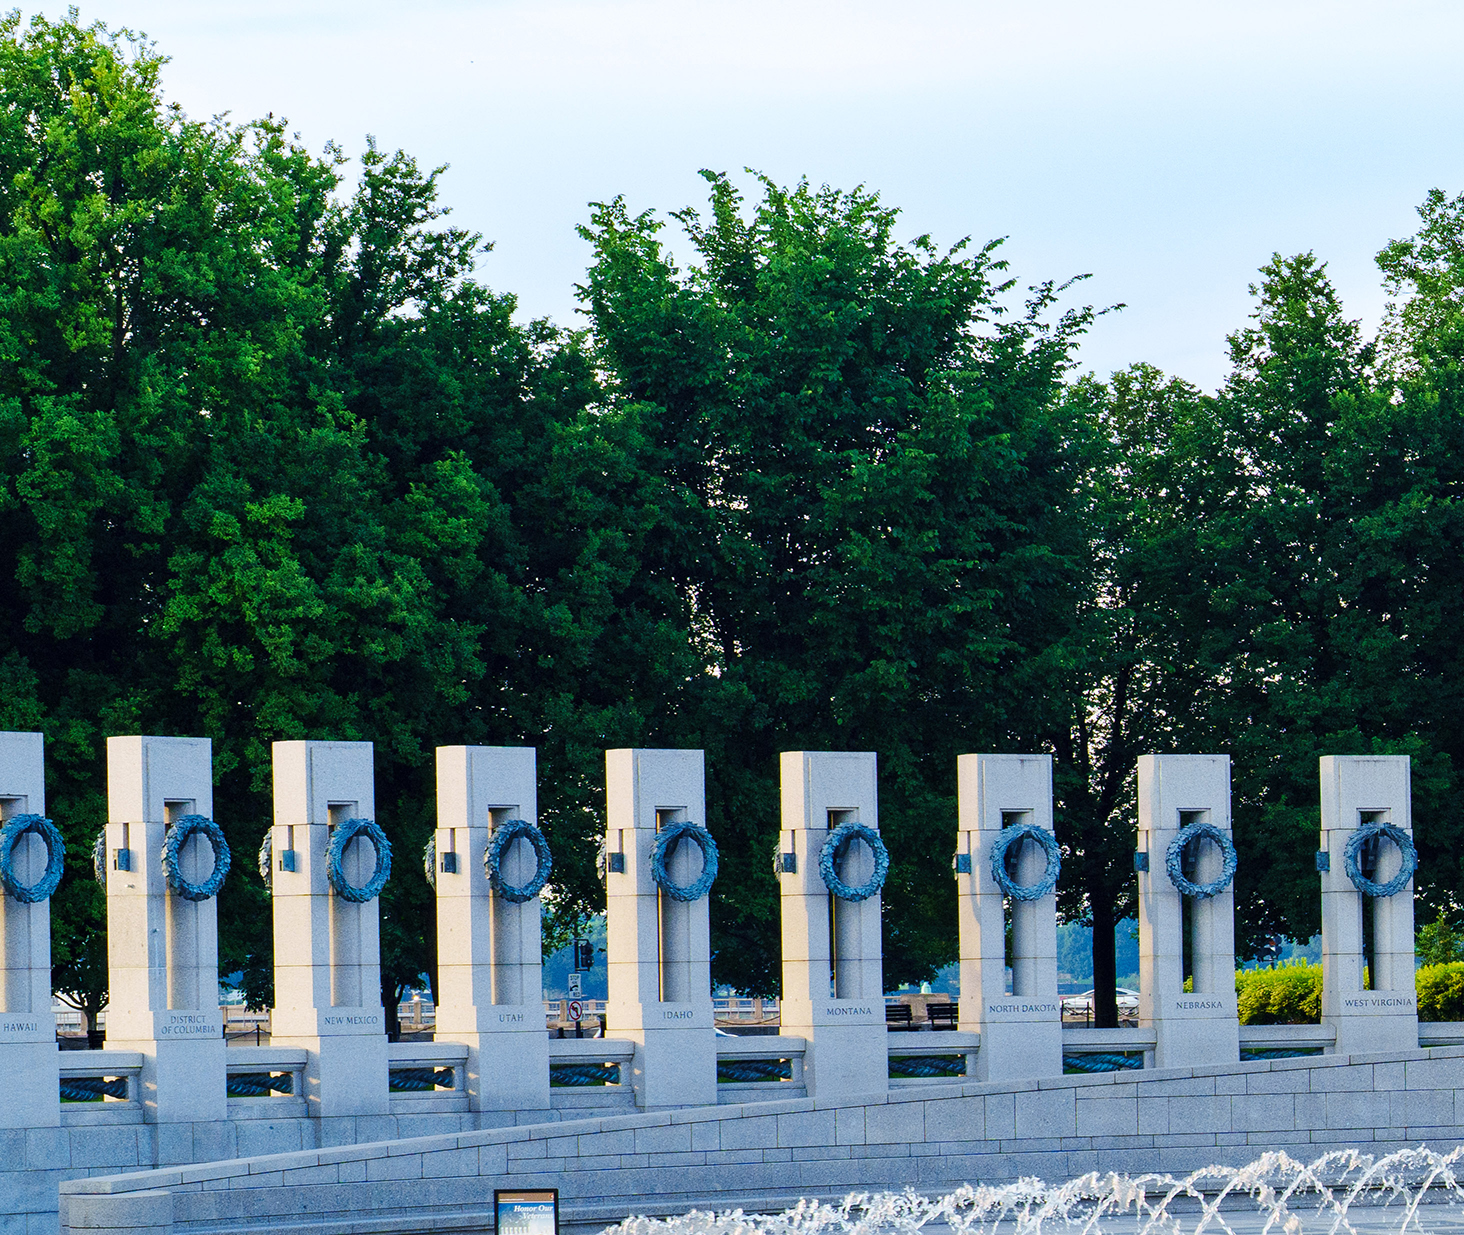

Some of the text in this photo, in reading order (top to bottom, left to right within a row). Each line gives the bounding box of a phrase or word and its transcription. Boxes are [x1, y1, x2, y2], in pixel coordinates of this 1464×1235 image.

[1176, 1001, 1223, 1010] NEBRASKA
[1344, 998, 1413, 1007] WEST VIRGINIA
[826, 1007, 872, 1016] MONTANA
[989, 1003, 1057, 1013] NORTH DAKOTA
[499, 1013, 524, 1022] UTAH
[663, 1010, 694, 1019] IDAHO
[170, 1015, 206, 1024] DISTRICT
[324, 1015, 378, 1025] NEW MEXICO
[3, 1022, 38, 1032] HAWAII
[161, 1024, 216, 1035] OF COLUMBIA
[513, 1204, 554, 1213] Honor Our
